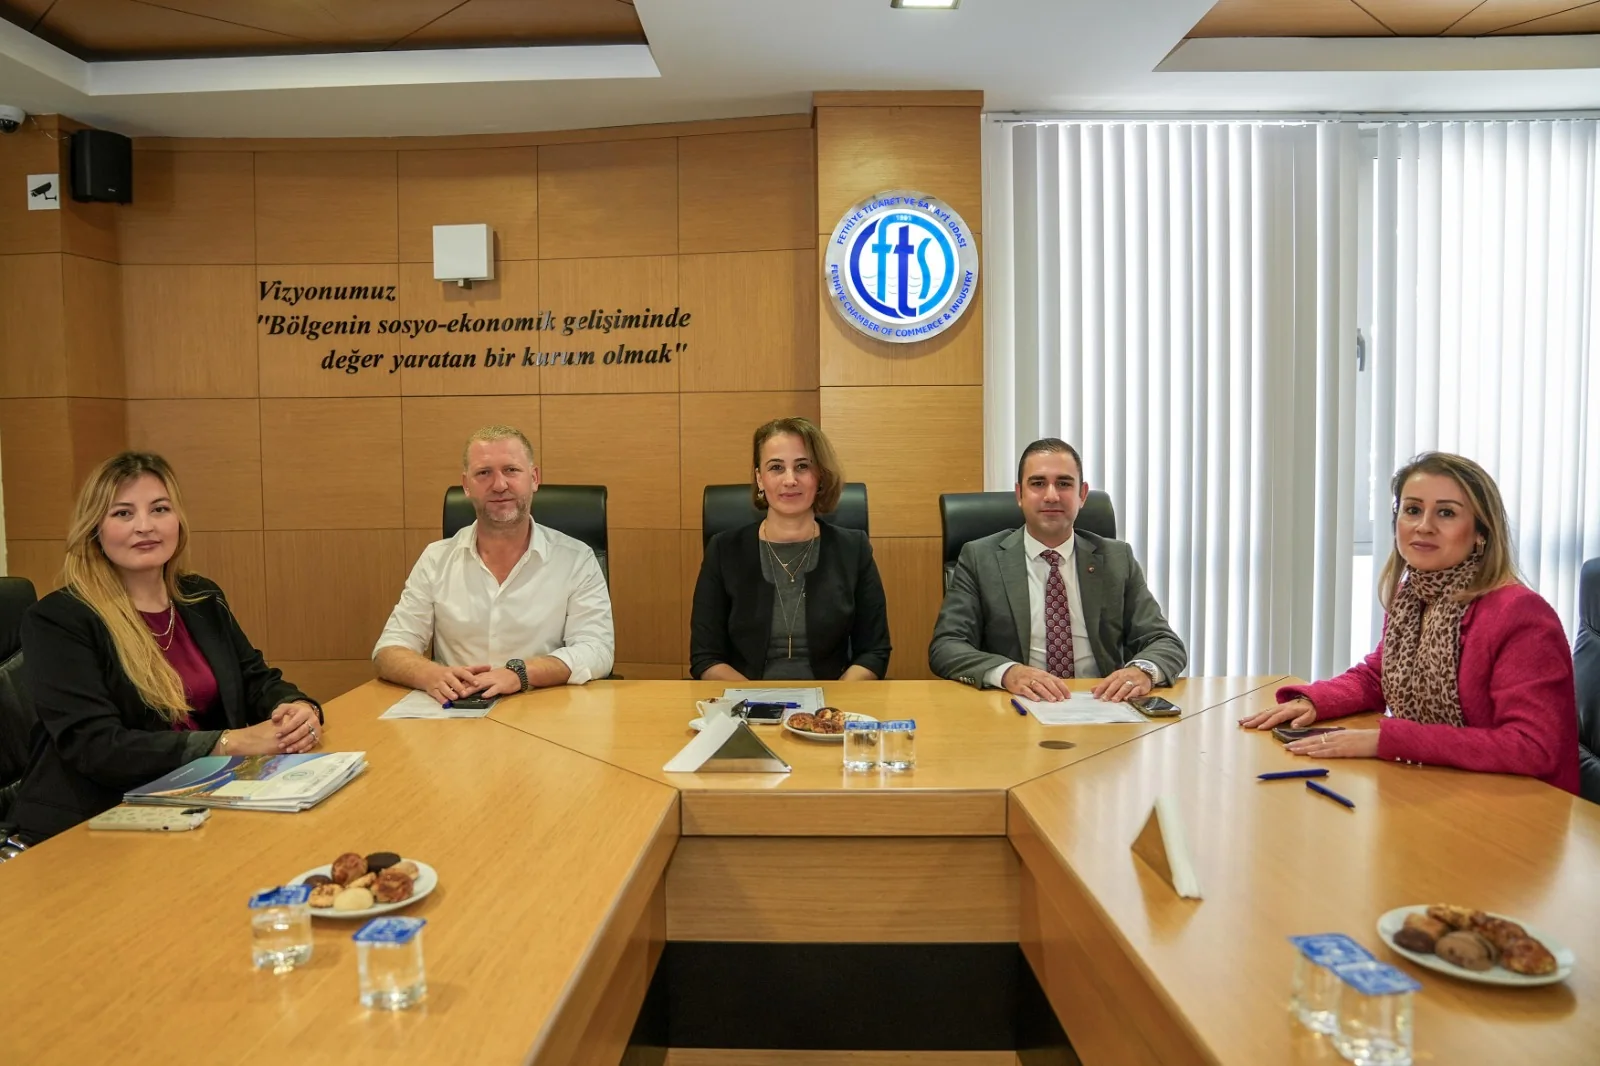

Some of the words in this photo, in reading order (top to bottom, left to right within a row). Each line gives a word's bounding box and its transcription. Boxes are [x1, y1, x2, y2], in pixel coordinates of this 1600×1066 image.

[903, 197, 916, 206] VE
[917, 200, 951, 223] SANAYİ
[948, 221, 967, 248] ODASI
[259, 280, 397, 306] Vizyonumuz
[843, 301, 879, 332] CHAMBER
[881, 328, 893, 337] OF
[895, 318, 944, 338] COMMERCE
[943, 312, 952, 321] &
[950, 270, 974, 313] INDUSTRY
[257, 314, 371, 340] "Bölgenin
[377, 309, 556, 340] sosyo-ekonomik
[561, 306, 691, 338] gelişiminde
[321, 349, 384, 374] değer
[388, 351, 477, 375] yaratan
[484, 346, 516, 368] bir
[521, 346, 595, 368] kurum
[602, 341, 689, 366] olmak"
